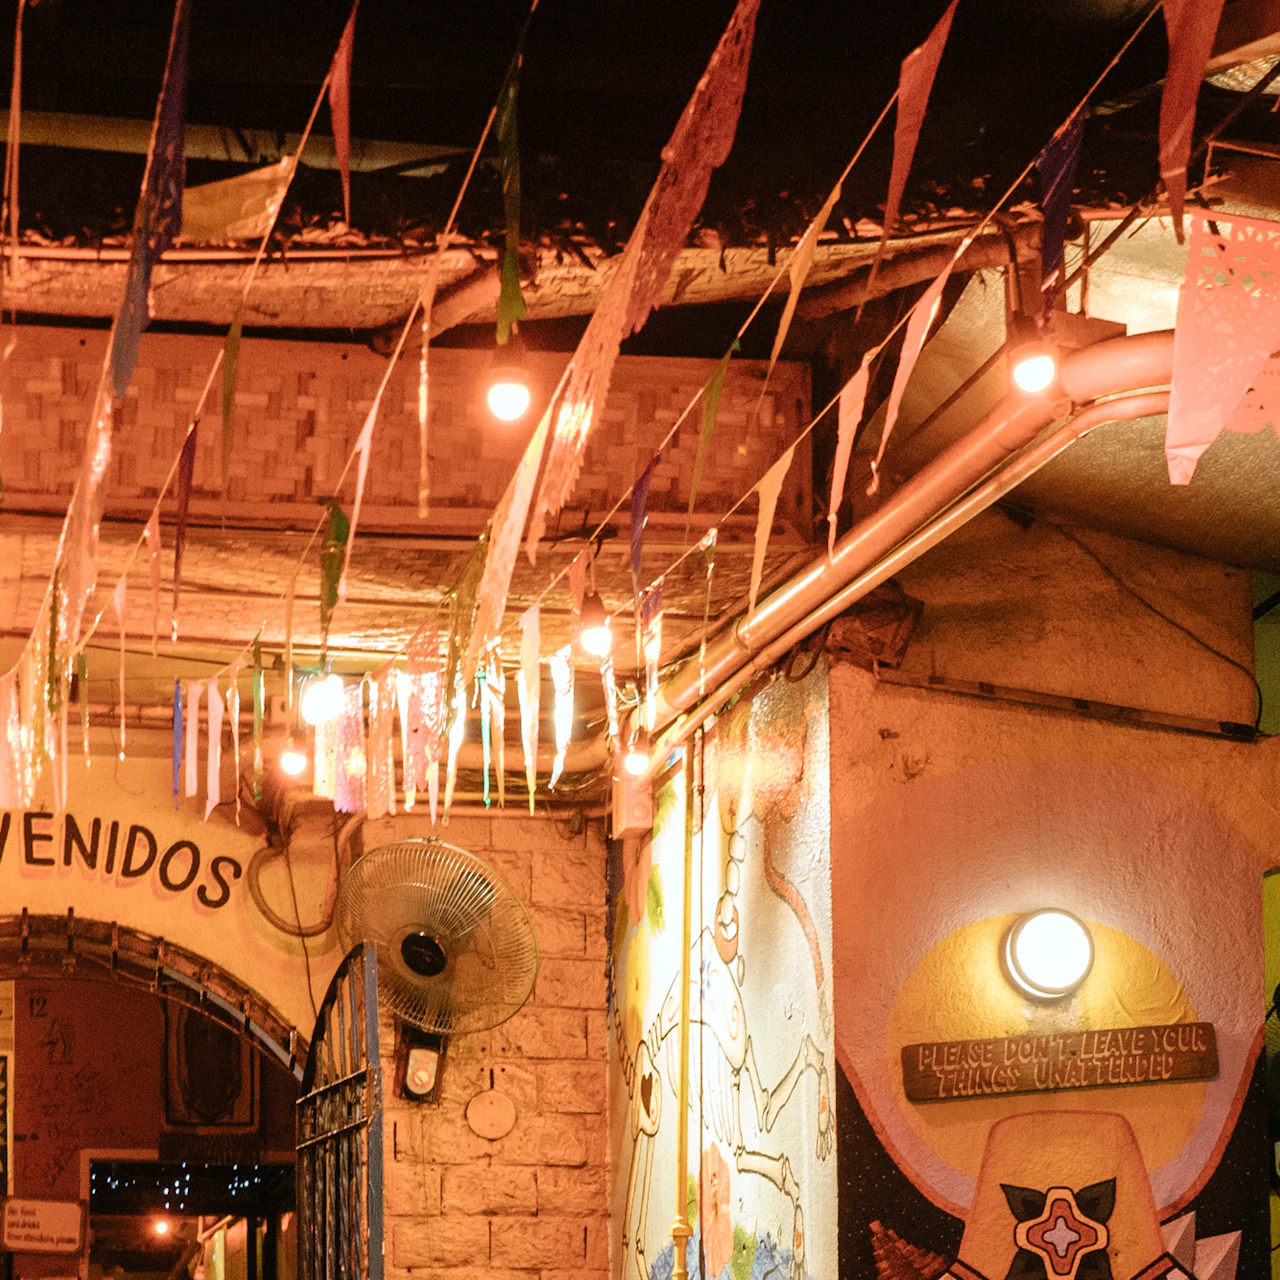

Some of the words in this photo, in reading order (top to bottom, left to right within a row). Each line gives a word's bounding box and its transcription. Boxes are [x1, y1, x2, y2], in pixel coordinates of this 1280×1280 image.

[918, 1043, 995, 1072] PLEASE
[1003, 1034, 1072, 1066] DON'T
[1080, 1029, 1146, 1060] LEAVE
[1151, 1026, 1207, 1053] YOUR
[935, 1065, 1022, 1098] THINGS
[1033, 1053, 1175, 1090] UNATTENDED
